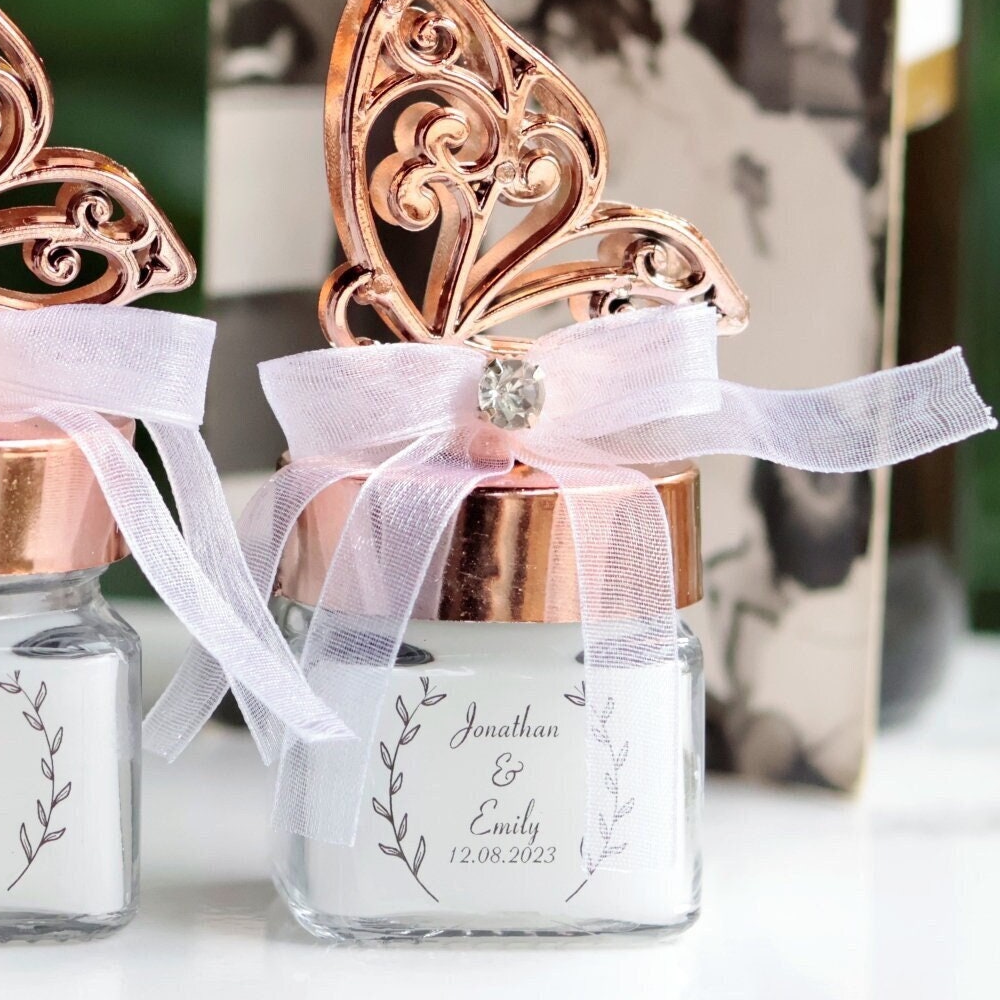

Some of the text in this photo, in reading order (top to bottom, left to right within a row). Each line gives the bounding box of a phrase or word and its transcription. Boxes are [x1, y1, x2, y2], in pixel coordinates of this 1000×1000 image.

[449, 701, 560, 749] Jonathan
[491, 752, 524, 787] &
[469, 798, 540, 845] Emily
[449, 846, 557, 864] 12.08.2023
